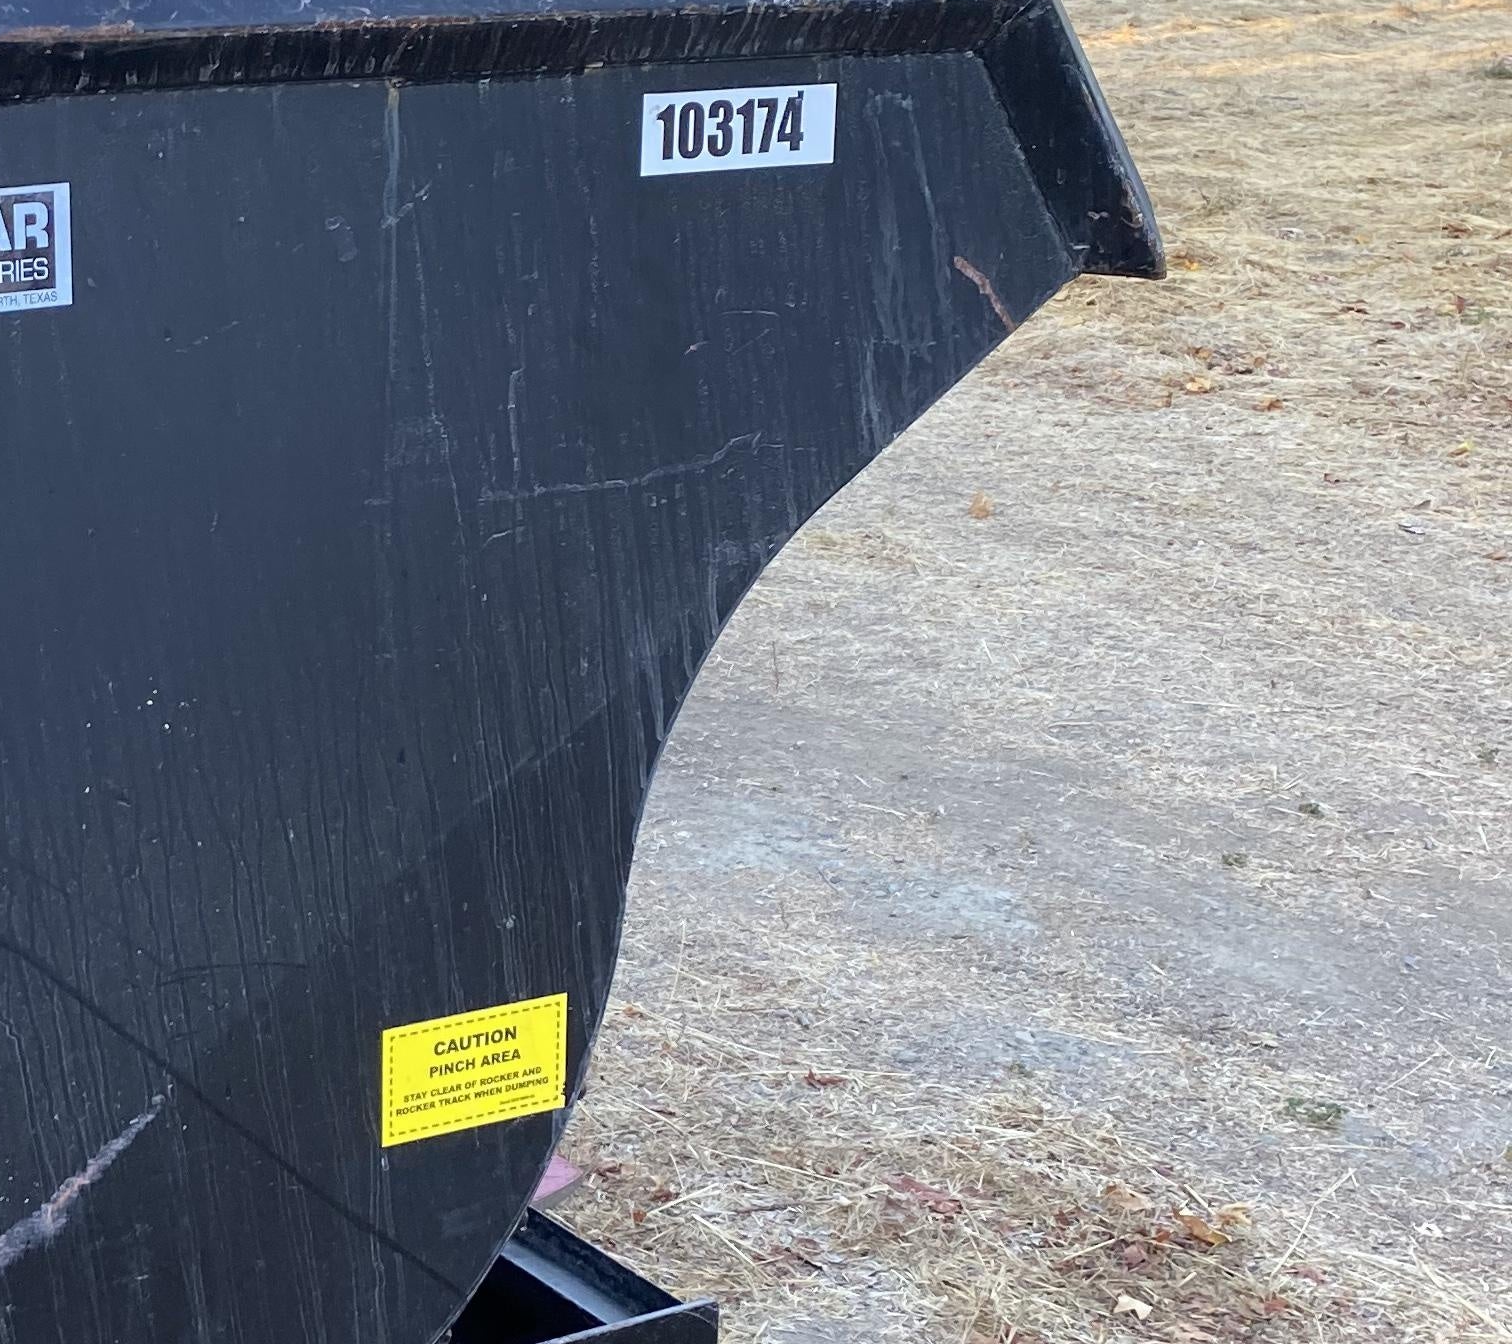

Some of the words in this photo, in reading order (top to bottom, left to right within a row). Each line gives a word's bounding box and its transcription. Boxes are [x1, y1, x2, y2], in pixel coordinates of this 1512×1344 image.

[656, 90, 805, 161] 103174
[23, 291, 58, 305] TEXAS
[434, 1025, 518, 1056] CAUTION
[430, 1057, 476, 1078] PINCH
[480, 1048, 521, 1068] AREA
[396, 1100, 436, 1117] ROCKER
[438, 1094, 471, 1108] TRACK
[473, 1086, 503, 1100] WHEN
[505, 1076, 549, 1093] DUMPING
[403, 1090, 428, 1103] STAY
[430, 1083, 462, 1097] CLEAR
[464, 1080, 478, 1090] OF
[479, 1071, 520, 1087] ROCKER
[522, 1066, 542, 1078] AND
